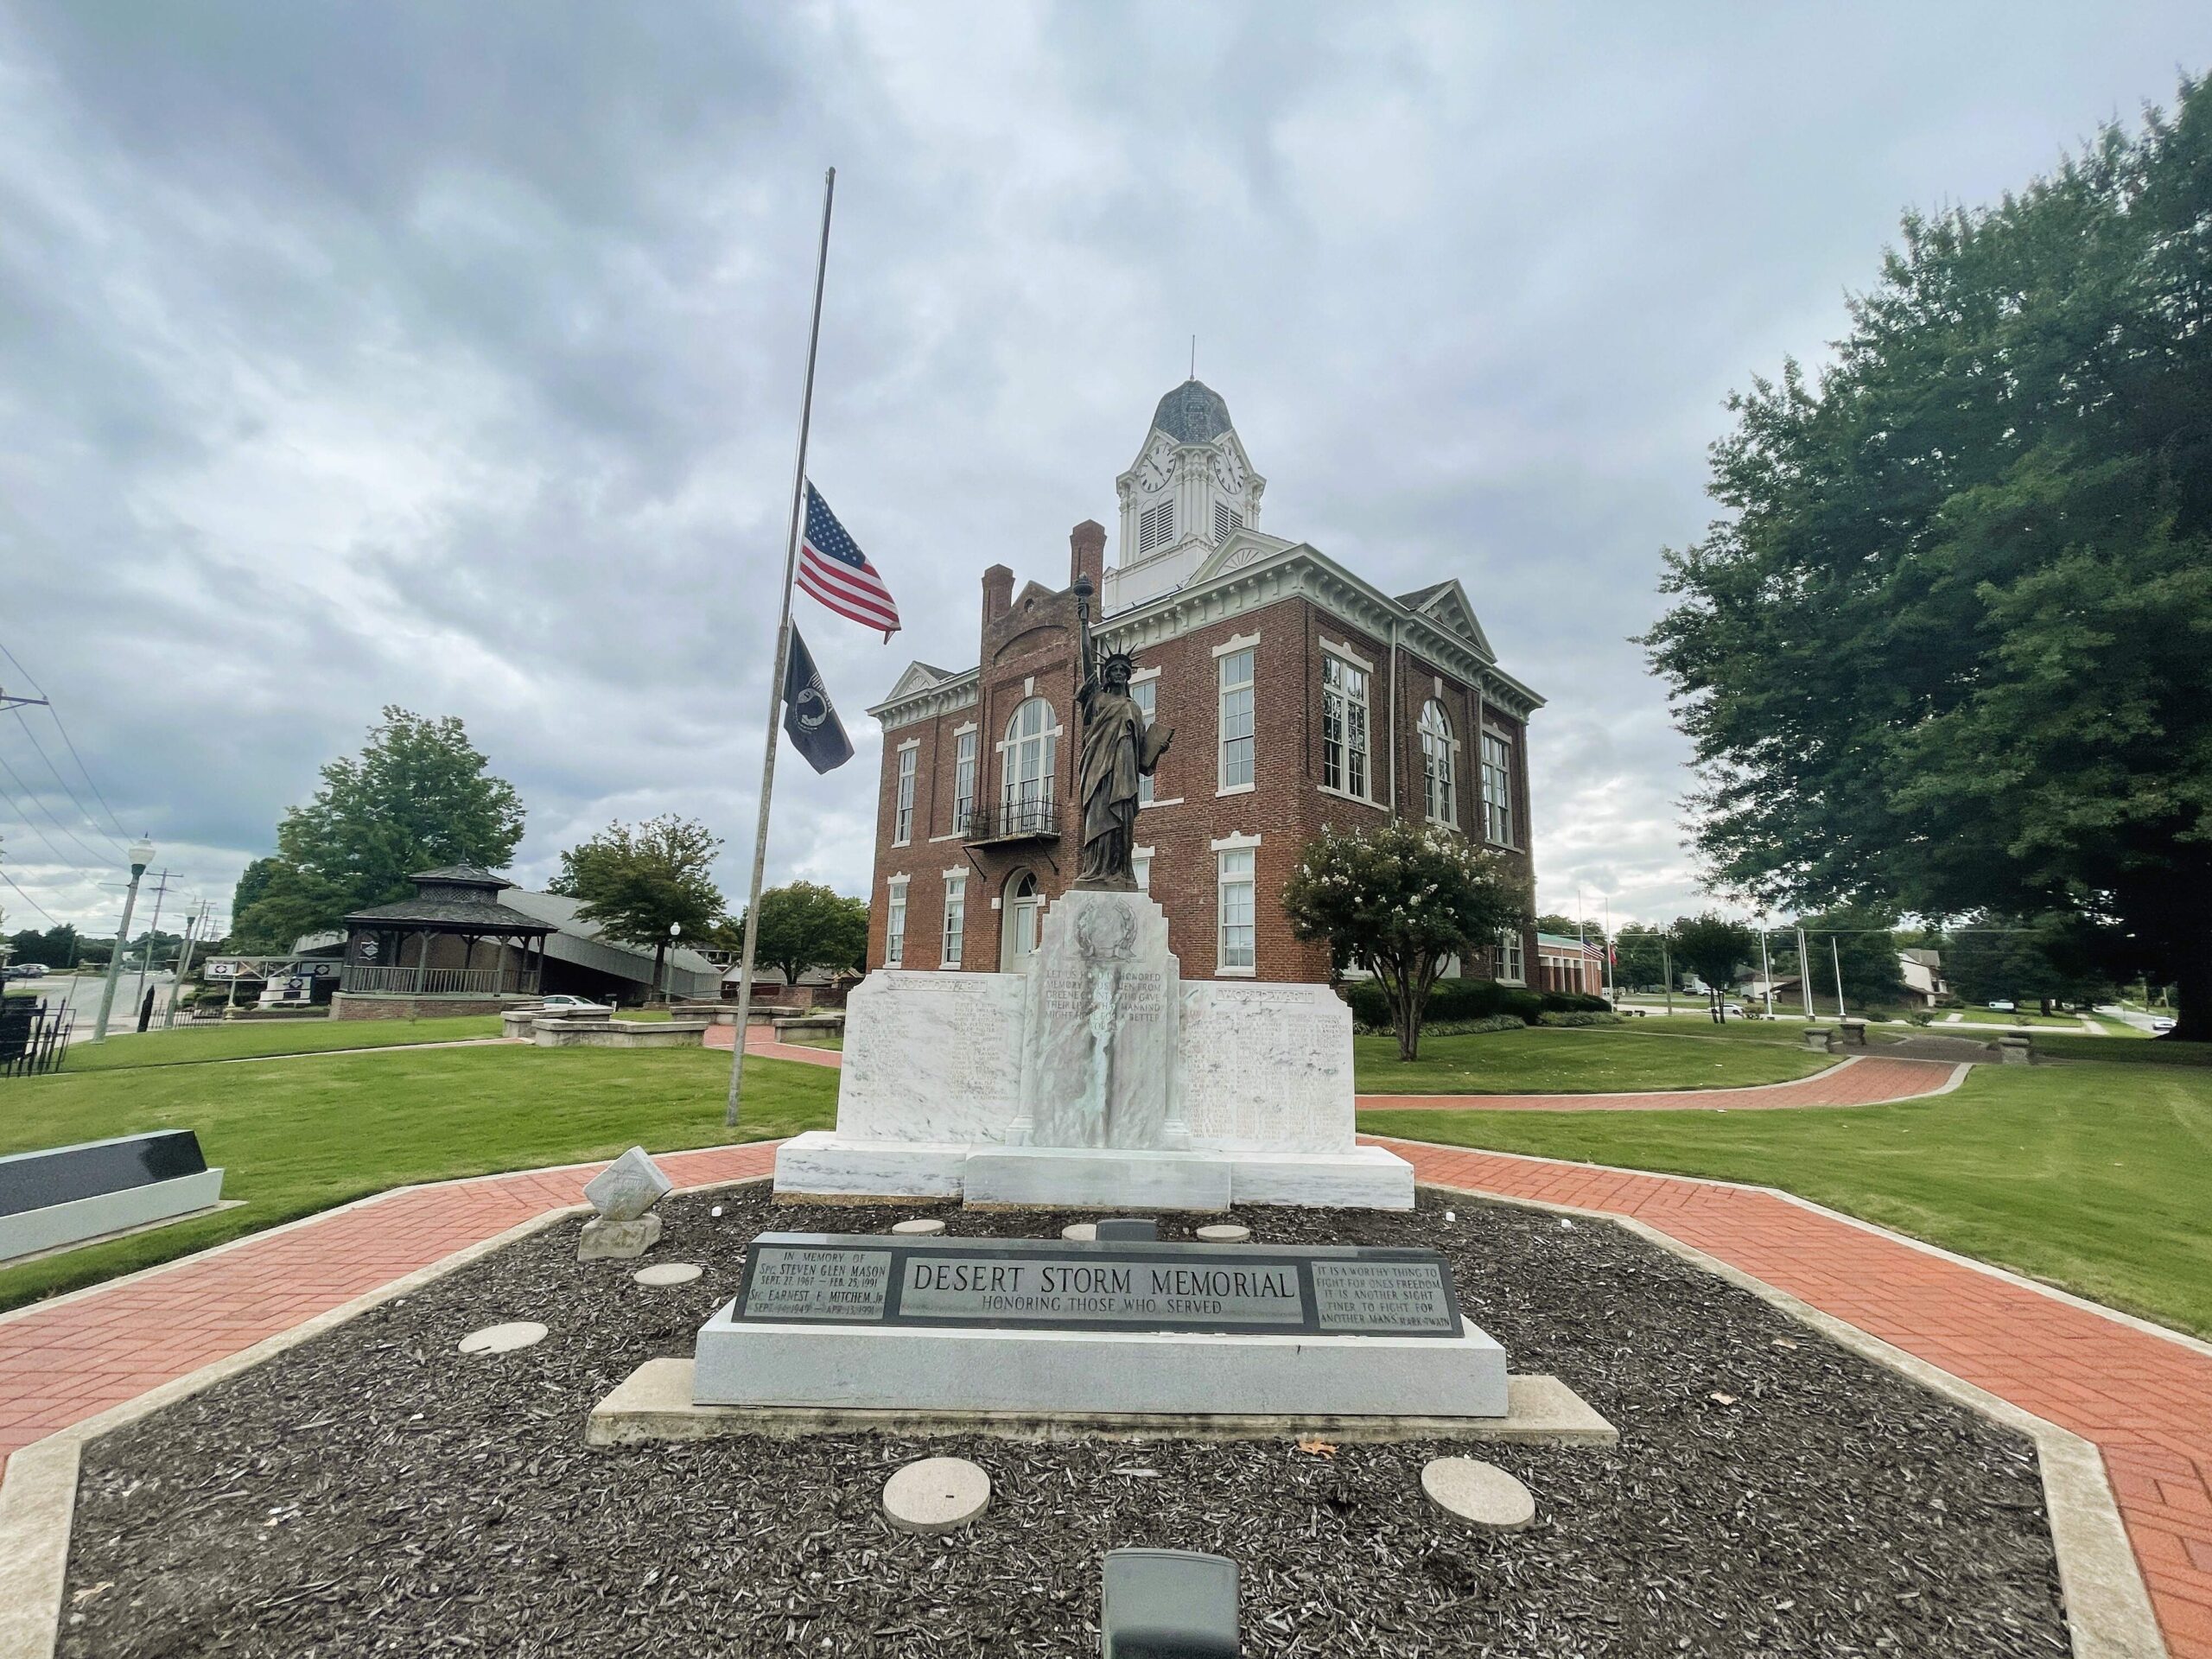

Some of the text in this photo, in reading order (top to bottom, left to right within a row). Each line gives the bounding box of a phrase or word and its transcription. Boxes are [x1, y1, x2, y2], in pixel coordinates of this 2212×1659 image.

[1065, 970, 1077, 979] US
[1121, 972, 1161, 982] HONORED
[1046, 980, 1083, 989] MEMORY
[1137, 983, 1161, 992] FROM
[1046, 990, 1079, 1000] GREENE
[1138, 993, 1161, 1002] GAVE
[1046, 1001, 1071, 1010] THEIR
[1121, 1003, 1161, 1013] MANKIND
[1046, 1011, 1074, 1020] MIGHT
[1128, 1014, 1160, 1023] BETTER
[784, 1252, 866, 1262] IN MEMORY OF
[779, 1264, 817, 1275] STEVEN
[820, 1265, 847, 1276] GLEN
[850, 1266, 886, 1277] MASON
[1330, 1267, 1338, 1275] IS
[1349, 1268, 1389, 1277] WORTHY
[1393, 1268, 1422, 1277] THING
[1426, 1268, 1437, 1278] TO
[760, 1275, 781, 1285] SEPT.
[797, 1277, 814, 1287] 1967
[861, 1279, 878, 1287] 1991
[913, 1265, 1295, 1299] DESERT STORM MEMORIAL
[1316, 1278, 1344, 1287] FIGHT
[1347, 1279, 1366, 1287] FOR
[768, 1290, 810, 1301] EARNEST
[1354, 1290, 1399, 1300] ANOTHER
[1403, 1291, 1433, 1300] SIGHT
[982, 1296, 1223, 1314] HONORING THOSE WHO SERVED
[1327, 1302, 1434, 1313] FINER TO FIGHT FOR
[1321, 1313, 1364, 1323] ANOTHER
